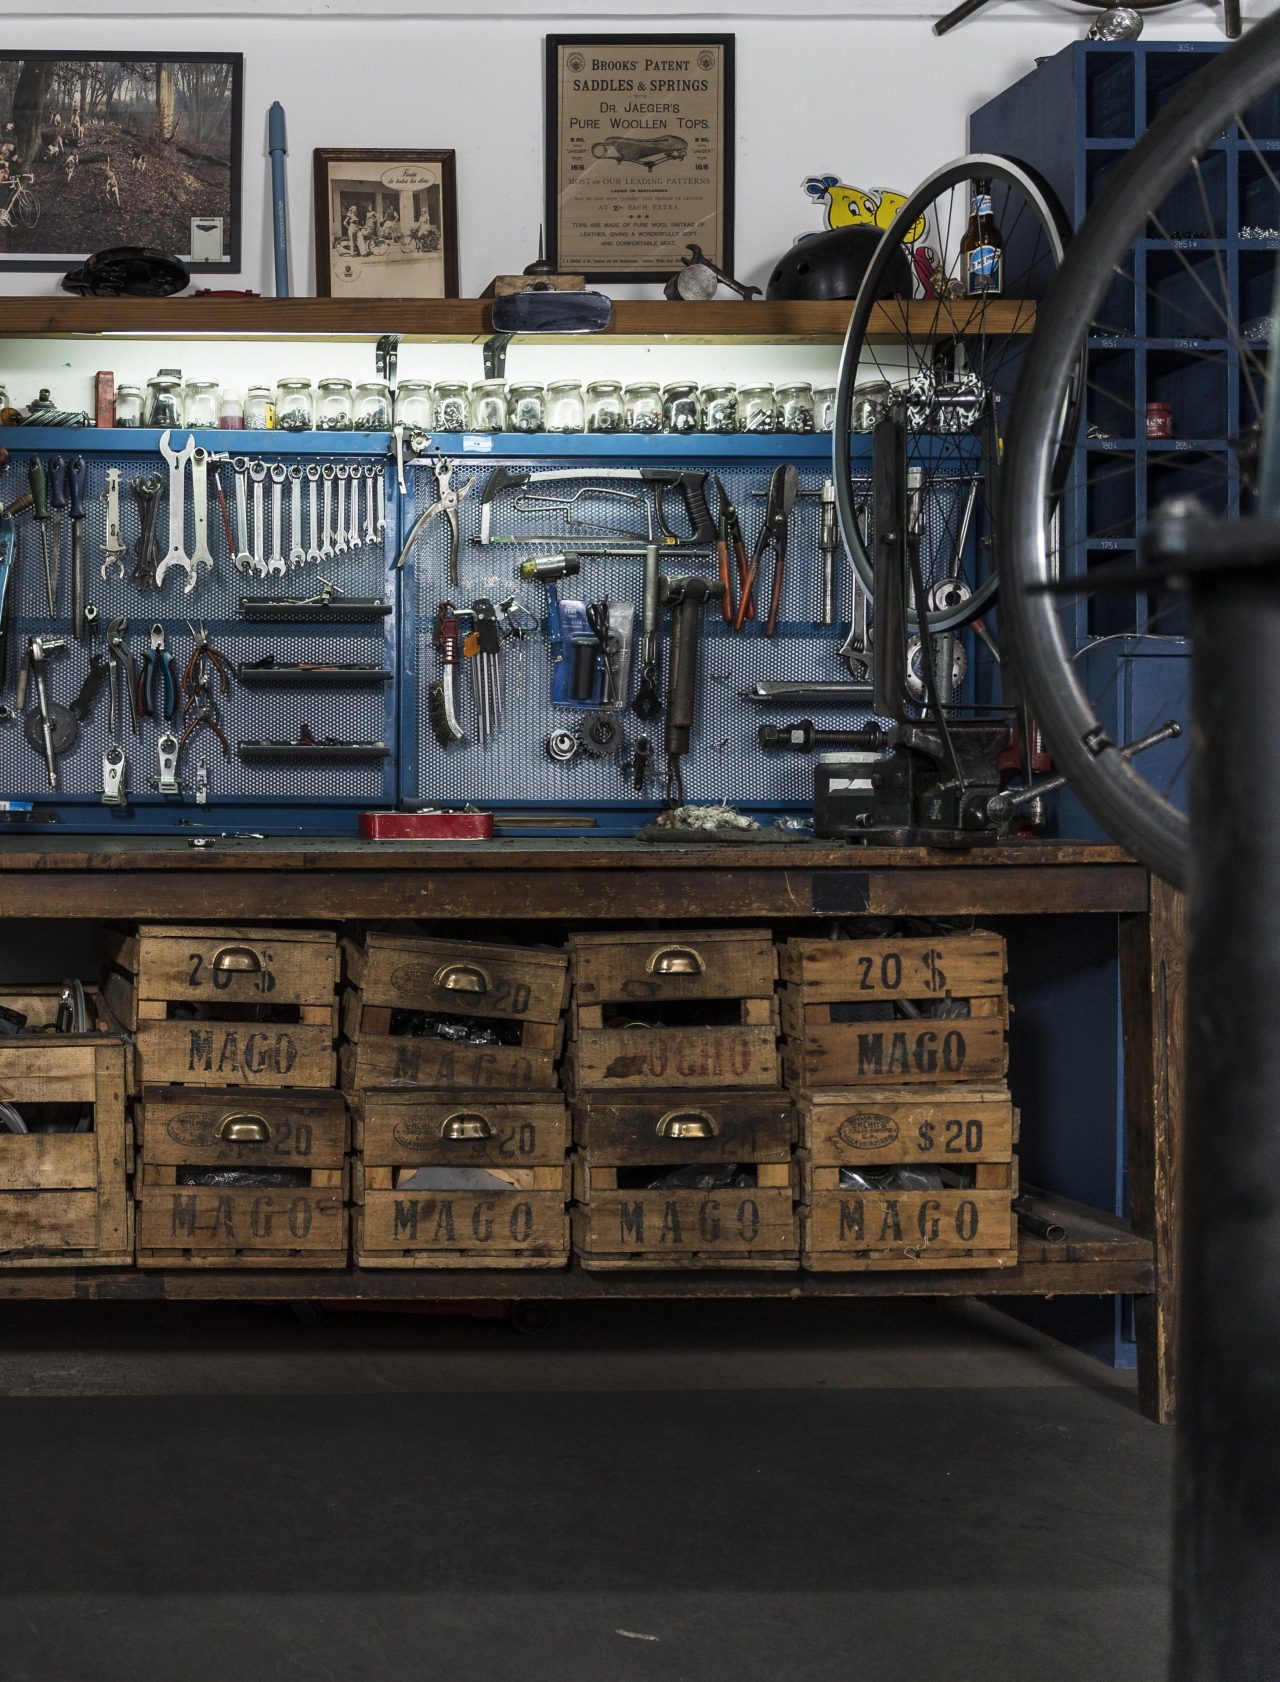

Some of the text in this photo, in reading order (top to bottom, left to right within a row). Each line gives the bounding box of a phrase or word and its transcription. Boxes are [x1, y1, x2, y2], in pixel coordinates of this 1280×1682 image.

[573, 80, 708, 91] SADDLES & SPRINGS
[592, 59, 690, 71] BROOKS' PATENT
[570, 118, 710, 129] PURE WOOLLEN TOPS.
[600, 102, 680, 113] DR. JAEGER'S
[858, 948, 947, 993] 20 $
[188, 1028, 299, 1076] MAGO
[395, 1043, 533, 1087] MAGO
[857, 1030, 968, 1077] MAGO
[273, 1118, 313, 1156] 20
[170, 1194, 314, 1241] MAGO
[393, 1199, 534, 1243] MAGO
[620, 1200, 760, 1245] MAGO
[838, 1200, 980, 1242] MAGO
